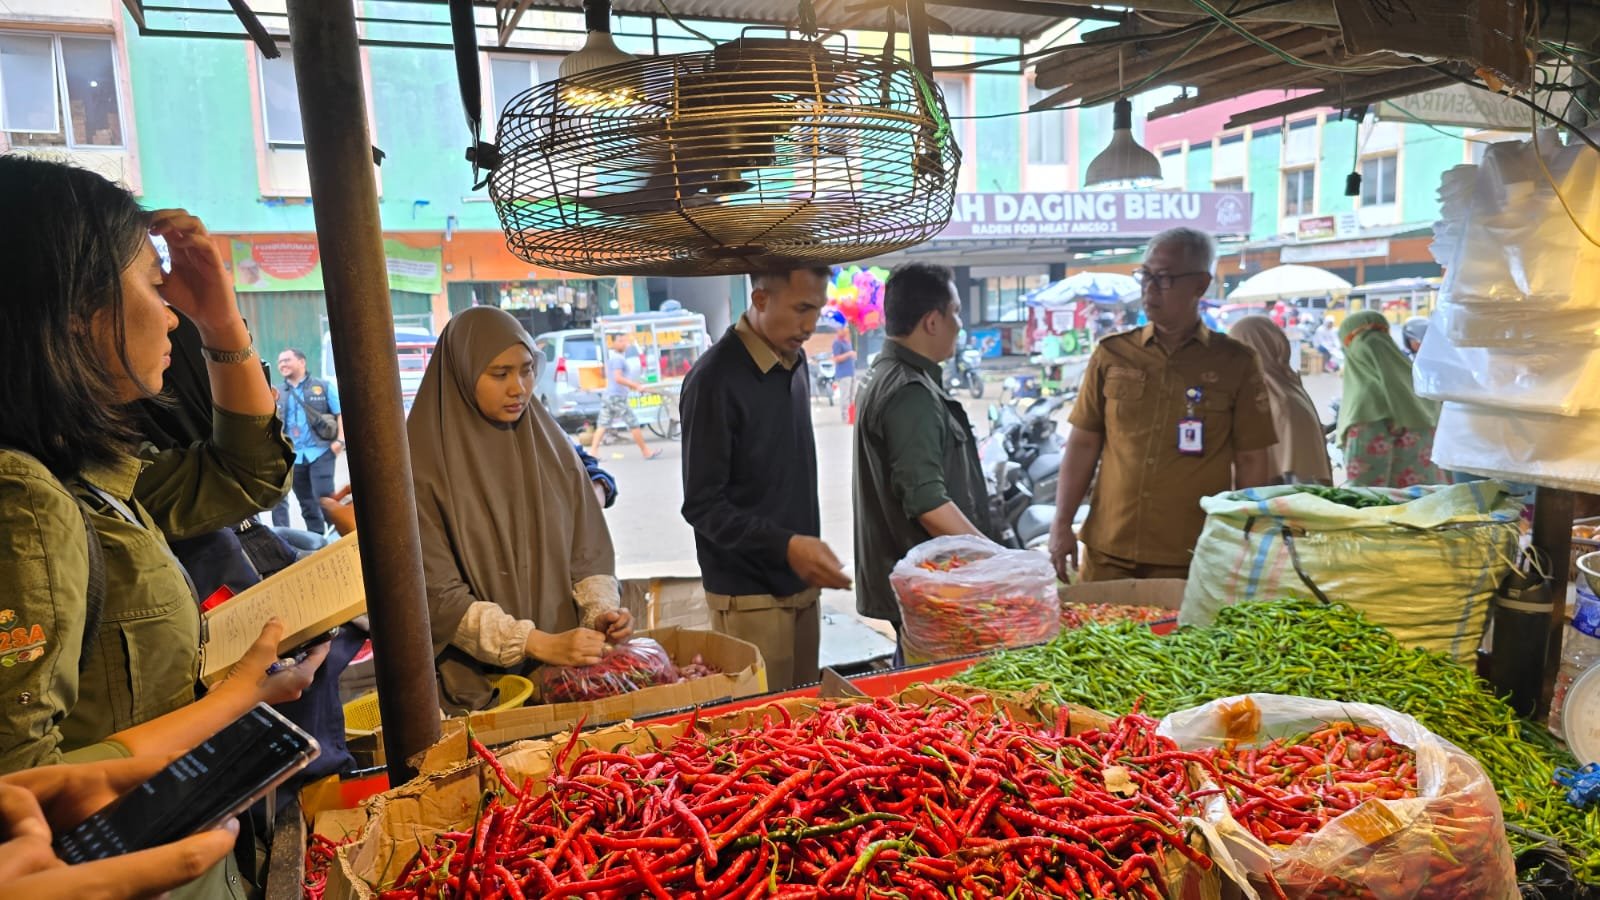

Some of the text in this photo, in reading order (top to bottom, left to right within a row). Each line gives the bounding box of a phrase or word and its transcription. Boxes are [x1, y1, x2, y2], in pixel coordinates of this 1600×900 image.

[994, 194, 1117, 221] DAGING
[1124, 193, 1201, 220] BEKU
[971, 223, 1012, 235] RADEN
[1014, 223, 1037, 234] FOR
[1039, 222, 1069, 234] MEAT
[1111, 221, 1118, 232] 2
